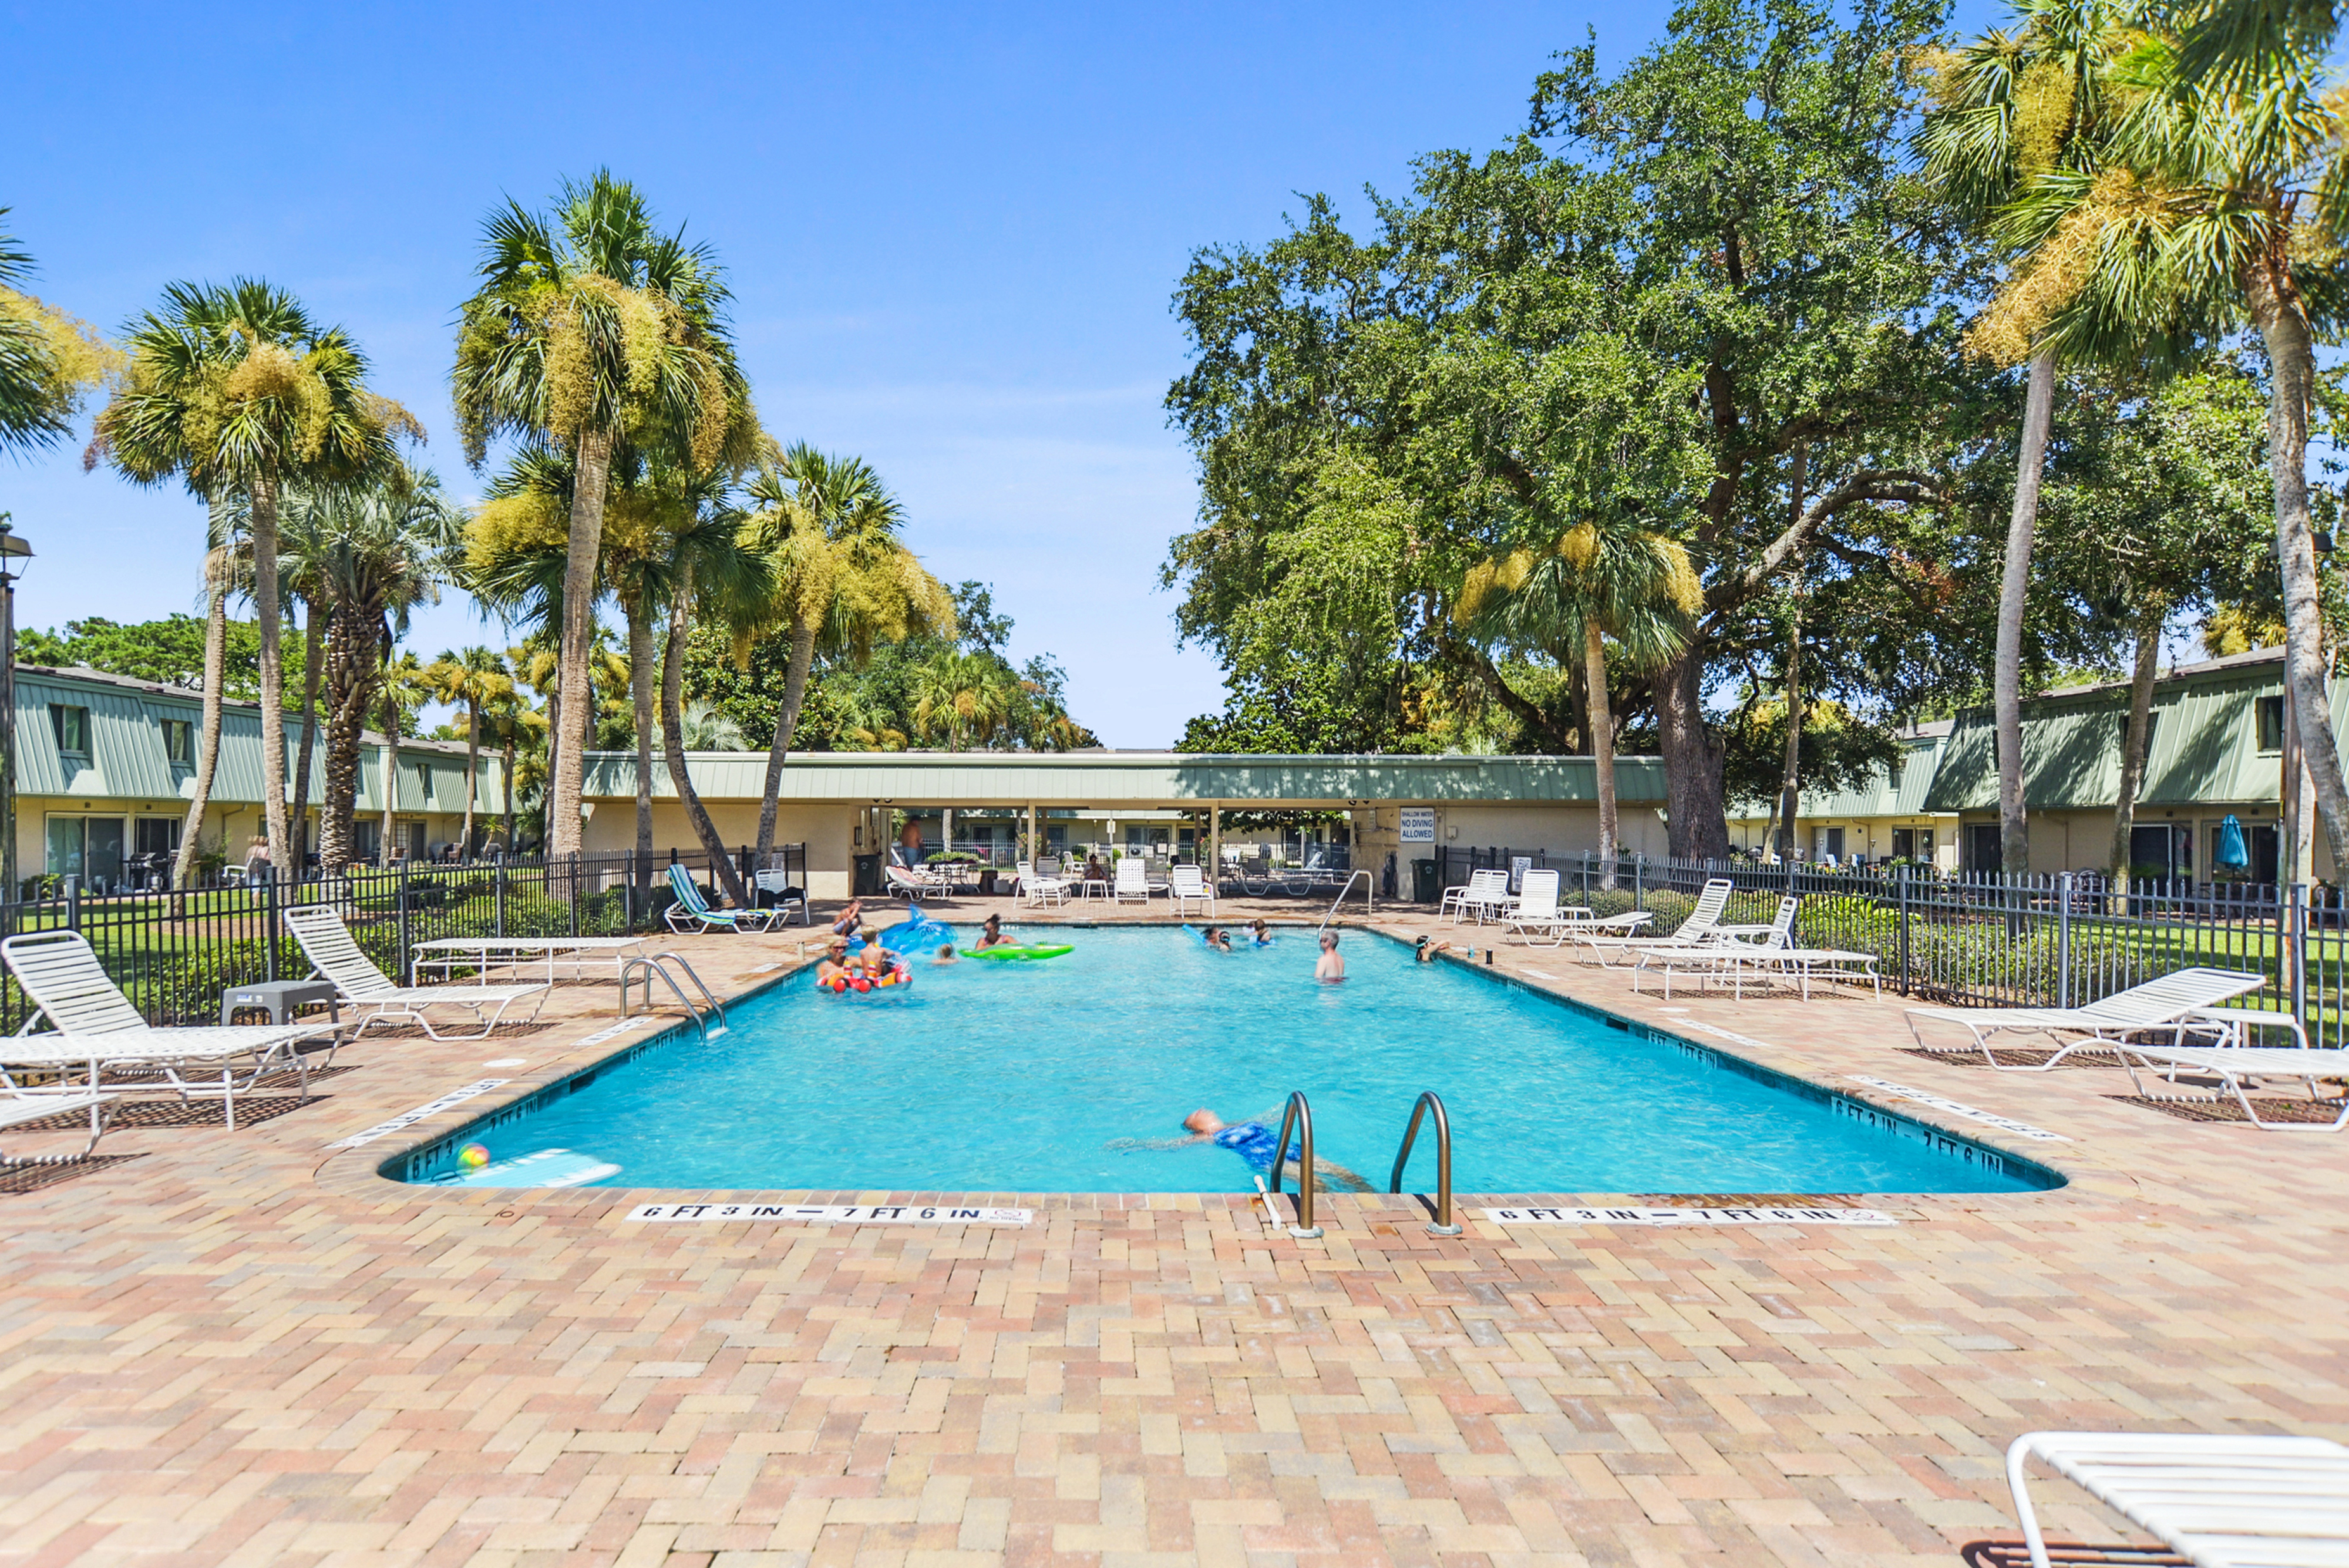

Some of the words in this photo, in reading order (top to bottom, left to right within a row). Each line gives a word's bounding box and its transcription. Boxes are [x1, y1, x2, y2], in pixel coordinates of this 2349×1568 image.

[1848, 1104, 1863, 1122] FT
[1923, 1130, 1931, 1146] 7
[1939, 1136, 1957, 1156] FT
[1981, 1152, 2000, 1175] IN
[413, 1155, 420, 1179] 6
[426, 1144, 441, 1173] FT
[643, 1207, 662, 1216] 6
[671, 1205, 712, 1217] FT
[721, 1206, 740, 1215] 3
[844, 1207, 859, 1217] 7
[870, 1207, 907, 1219] FT
[920, 1207, 937, 1219] 6
[1499, 1210, 1519, 1219] 6
[1527, 1209, 1563, 1220] FT
[1576, 1210, 1597, 1219] 3
[1692, 1210, 1711, 1219] 7
[1721, 1210, 1761, 1220] FT
[1771, 1210, 1795, 1219] 6
